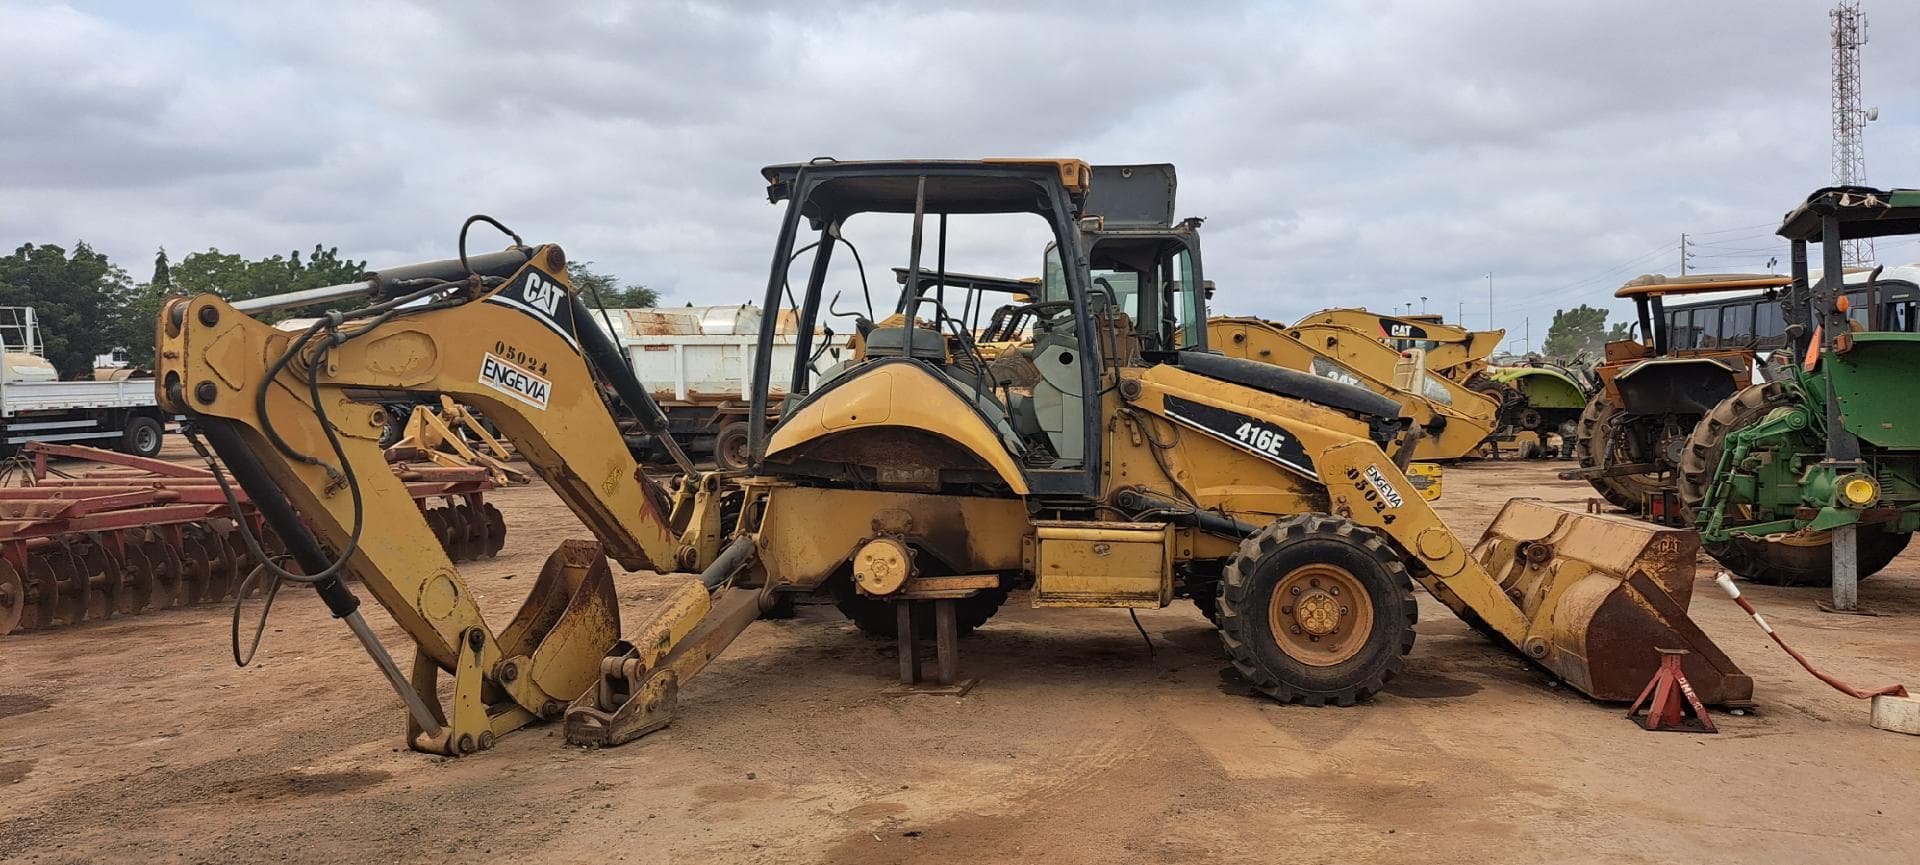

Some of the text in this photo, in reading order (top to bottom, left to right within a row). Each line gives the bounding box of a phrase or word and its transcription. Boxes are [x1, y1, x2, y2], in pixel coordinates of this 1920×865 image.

[523, 272, 565, 317] CAT
[1391, 325, 1412, 337] CAT
[495, 340, 548, 376] 05024
[483, 358, 546, 403] ENGEVIA
[1235, 422, 1286, 456] 416E
[1347, 468, 1397, 525] 05024
[1364, 465, 1402, 509] ENGEVIA
[1660, 540, 1681, 553] CAT
